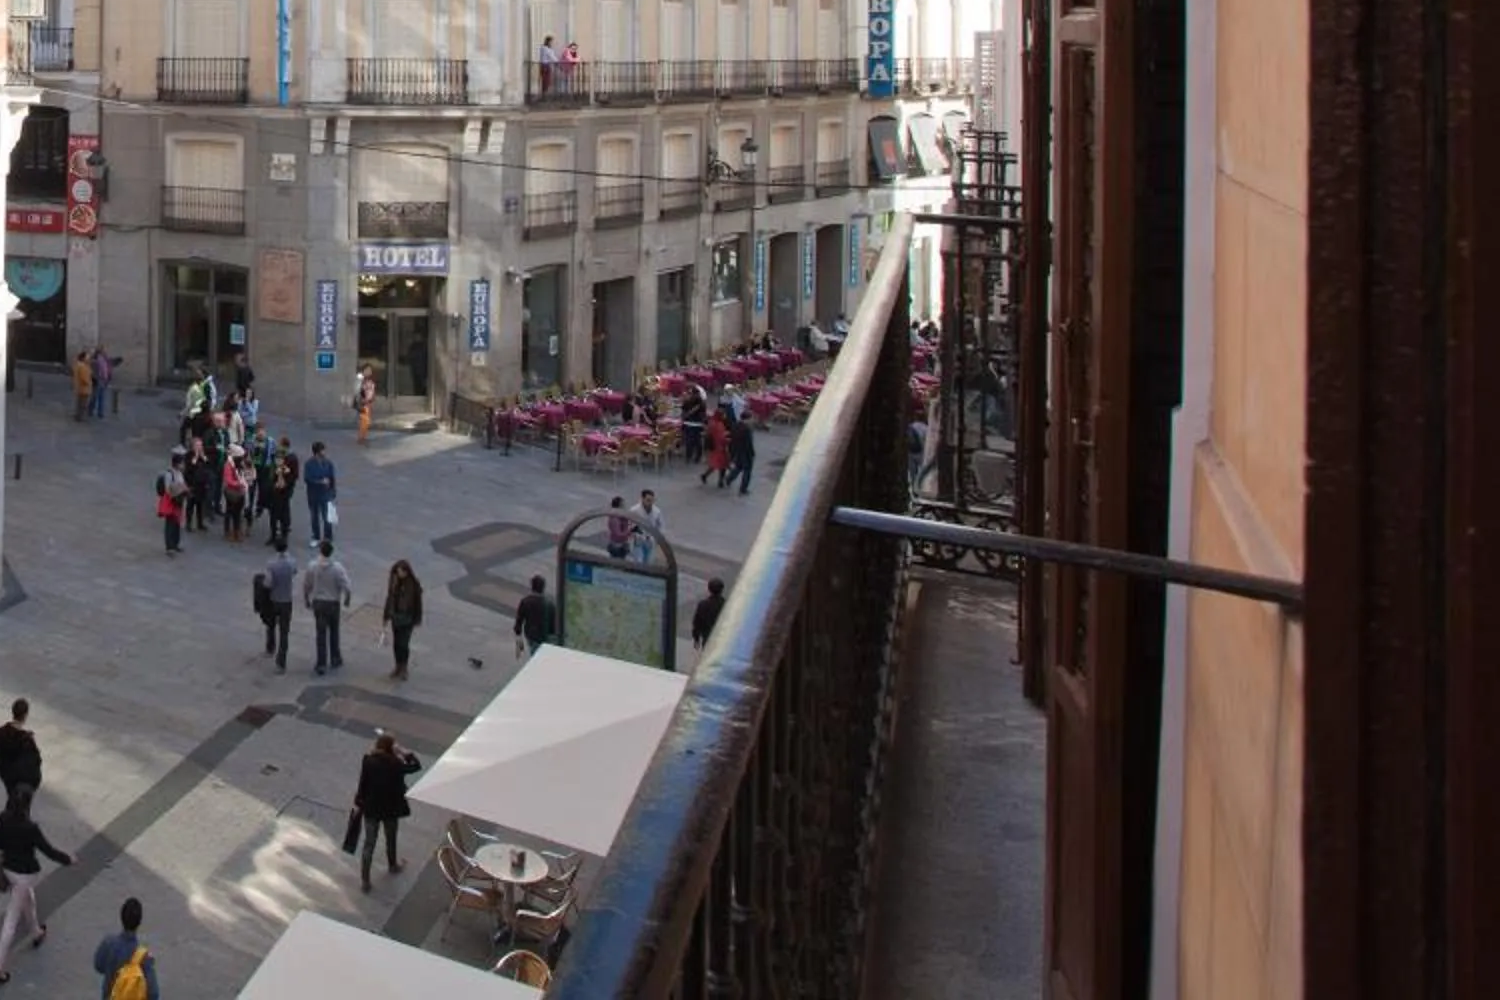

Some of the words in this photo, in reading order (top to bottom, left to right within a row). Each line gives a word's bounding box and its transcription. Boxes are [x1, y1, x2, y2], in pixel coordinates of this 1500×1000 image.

[363, 245, 445, 267] HOTEL
[320, 282, 334, 346] EUROPA
[473, 283, 487, 347] EUROPA
